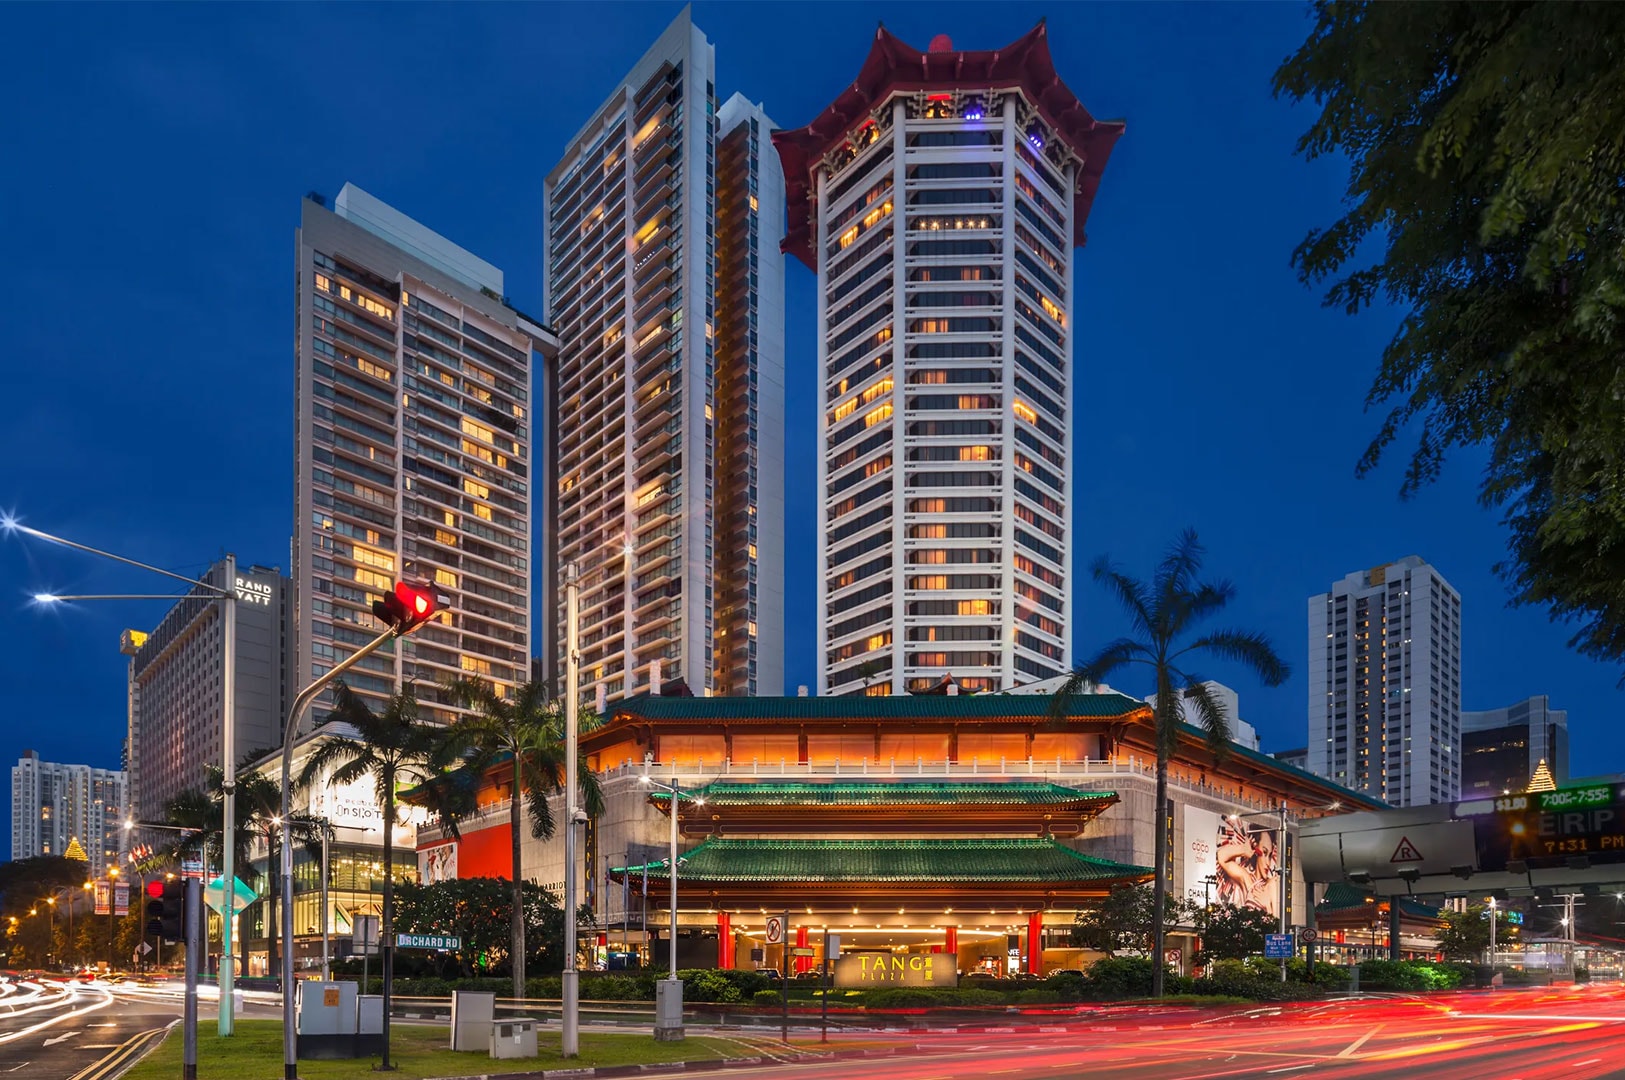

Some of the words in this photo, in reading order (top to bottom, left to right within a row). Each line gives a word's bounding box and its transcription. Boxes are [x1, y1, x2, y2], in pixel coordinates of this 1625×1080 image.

[236, 578, 272, 594] RAND
[236, 590, 270, 606] YATT
[1538, 810, 1615, 837] ERP
[1544, 839, 1588, 853] 7:31
[1600, 835, 1625, 849] PM
[1401, 847, 1411, 858] R
[1188, 888, 1211, 900] CHANL
[399, 935, 443, 947] ORCHARD
[445, 938, 458, 948] RD
[857, 956, 922, 970] TANG
[861, 972, 904, 981] PLAZA
